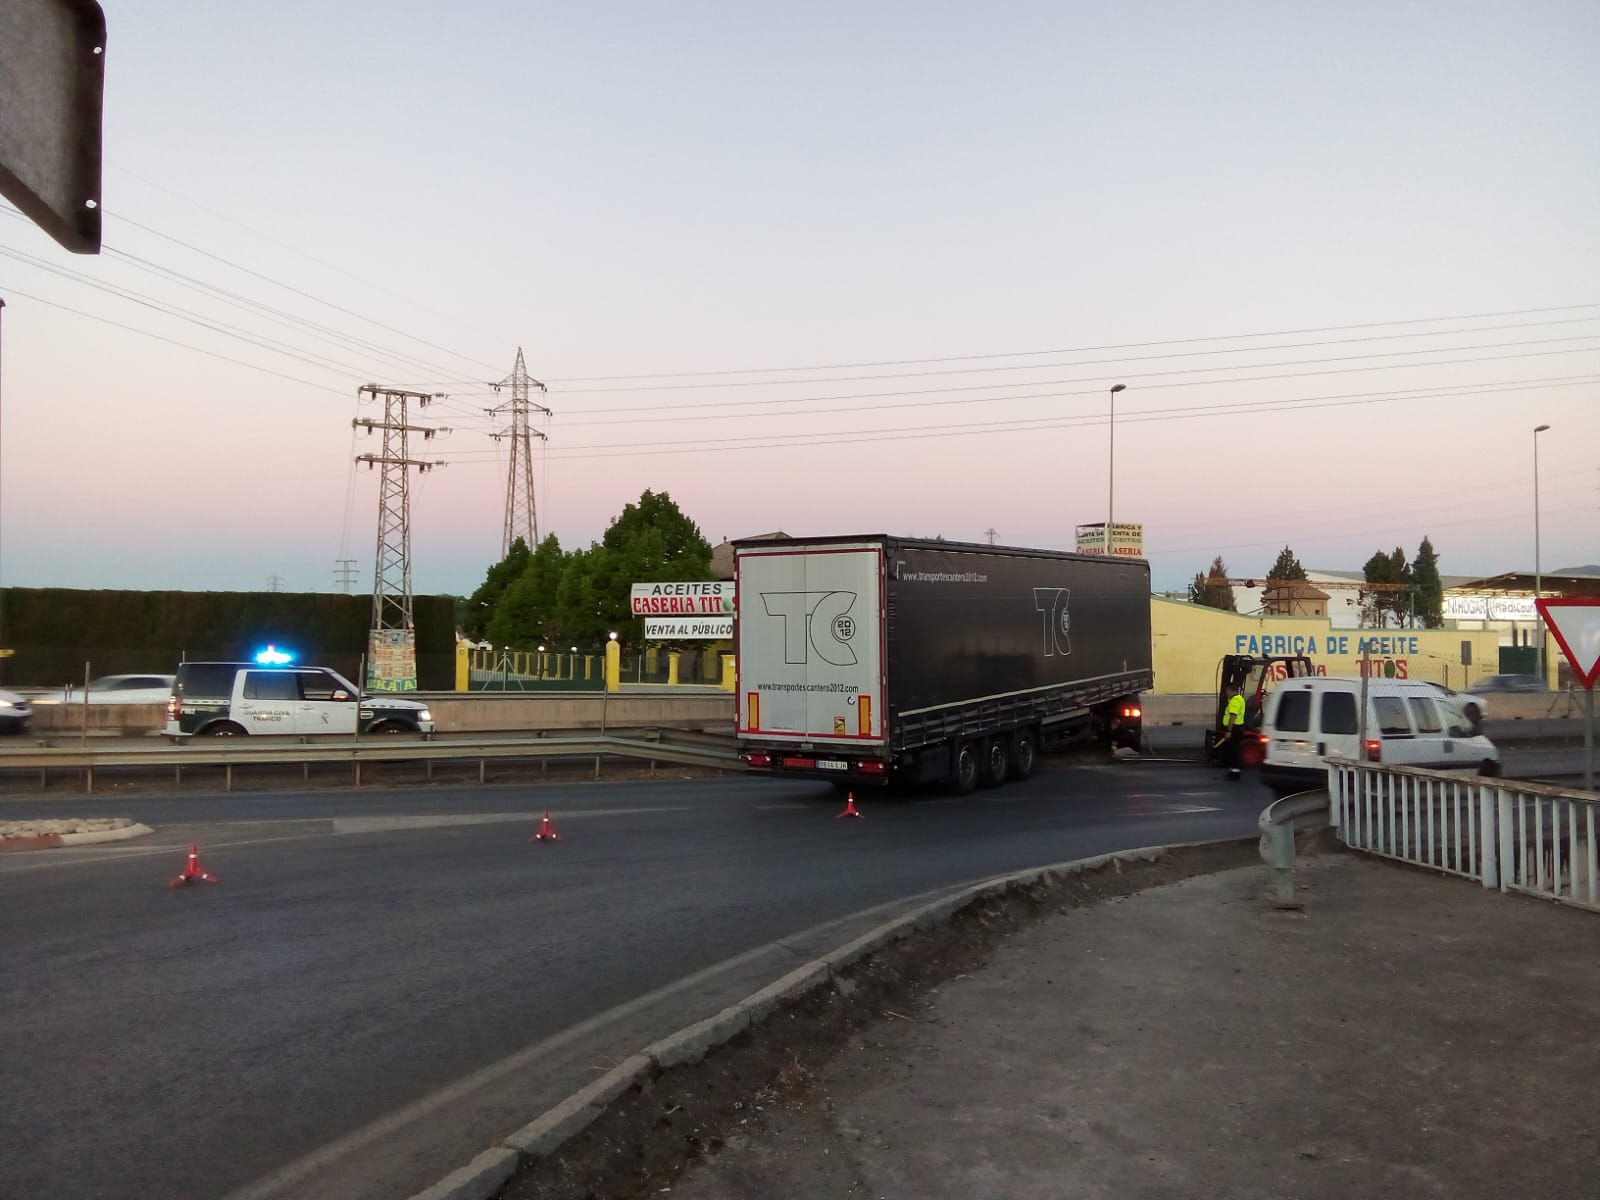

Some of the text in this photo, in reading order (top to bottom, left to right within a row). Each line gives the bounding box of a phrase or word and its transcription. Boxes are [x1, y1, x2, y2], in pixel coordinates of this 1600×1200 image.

[652, 584, 722, 595] ACEITES
[633, 597, 696, 613] CASERIA
[646, 625, 675, 634] VENTA
[678, 625, 689, 634] AL
[1235, 635, 1419, 655] FABRICA DE ACEITE
